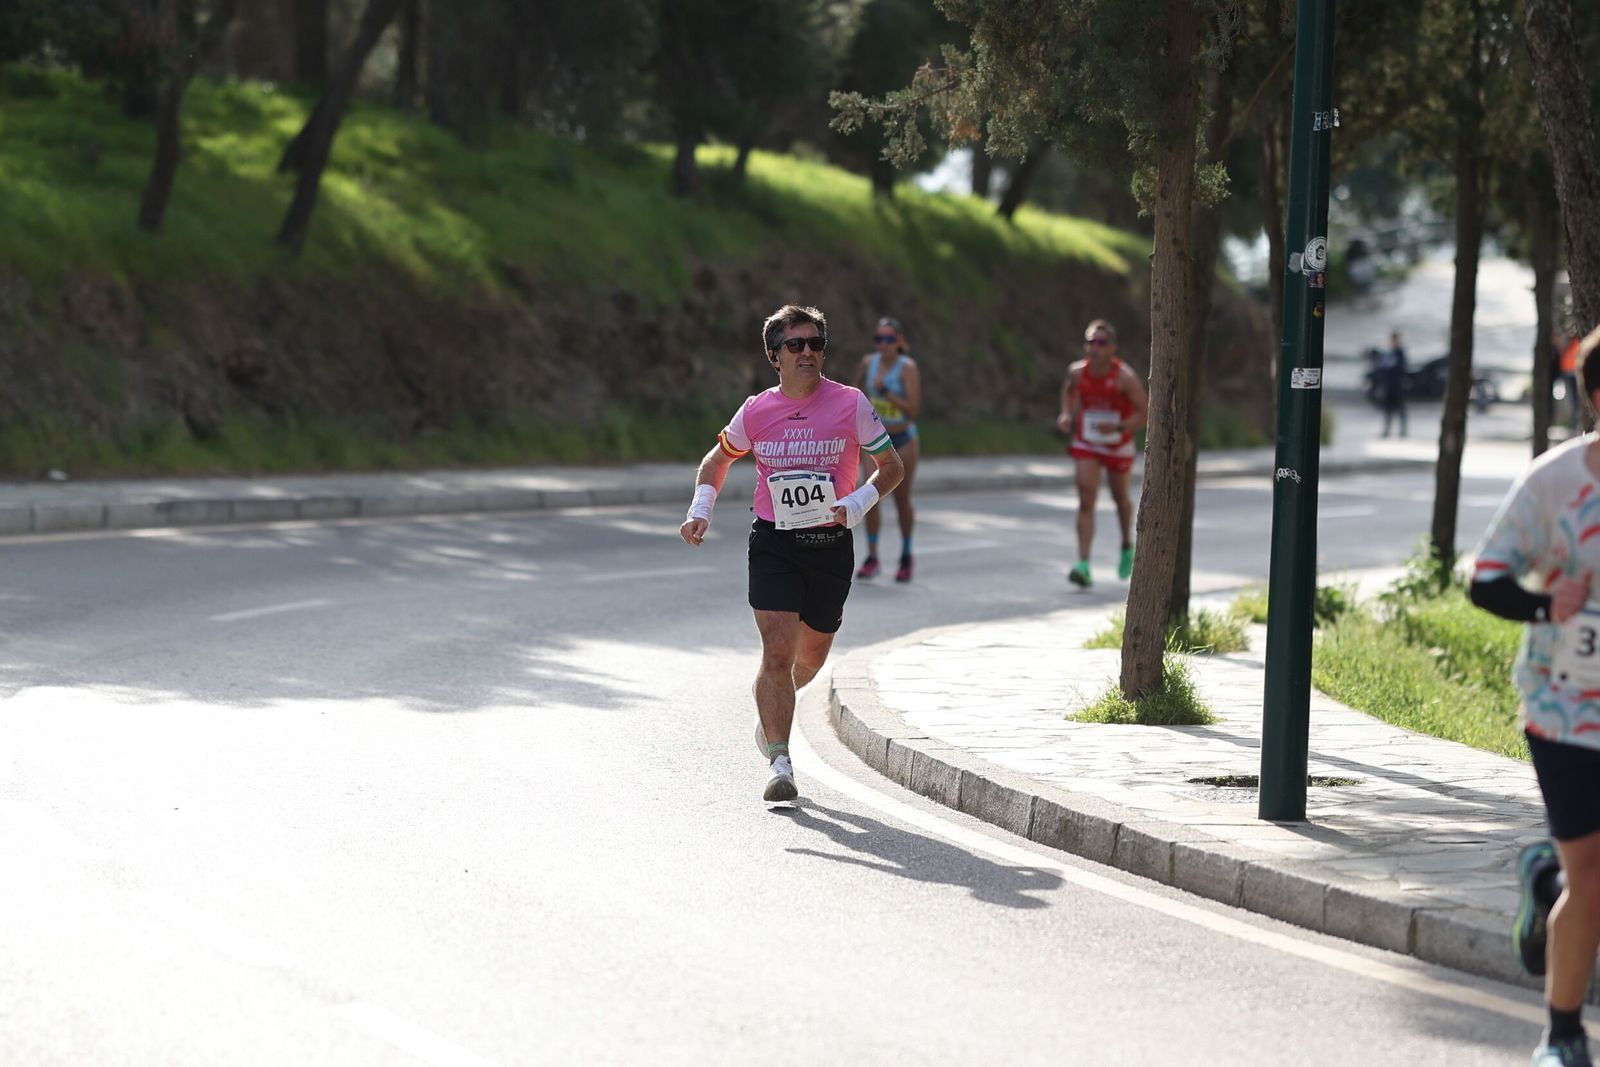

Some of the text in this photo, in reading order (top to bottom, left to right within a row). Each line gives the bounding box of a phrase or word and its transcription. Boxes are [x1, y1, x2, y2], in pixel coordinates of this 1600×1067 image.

[783, 428, 813, 440] XXXVI
[754, 438, 846, 456] MEDIA MARATÓN
[781, 484, 825, 508] 404
